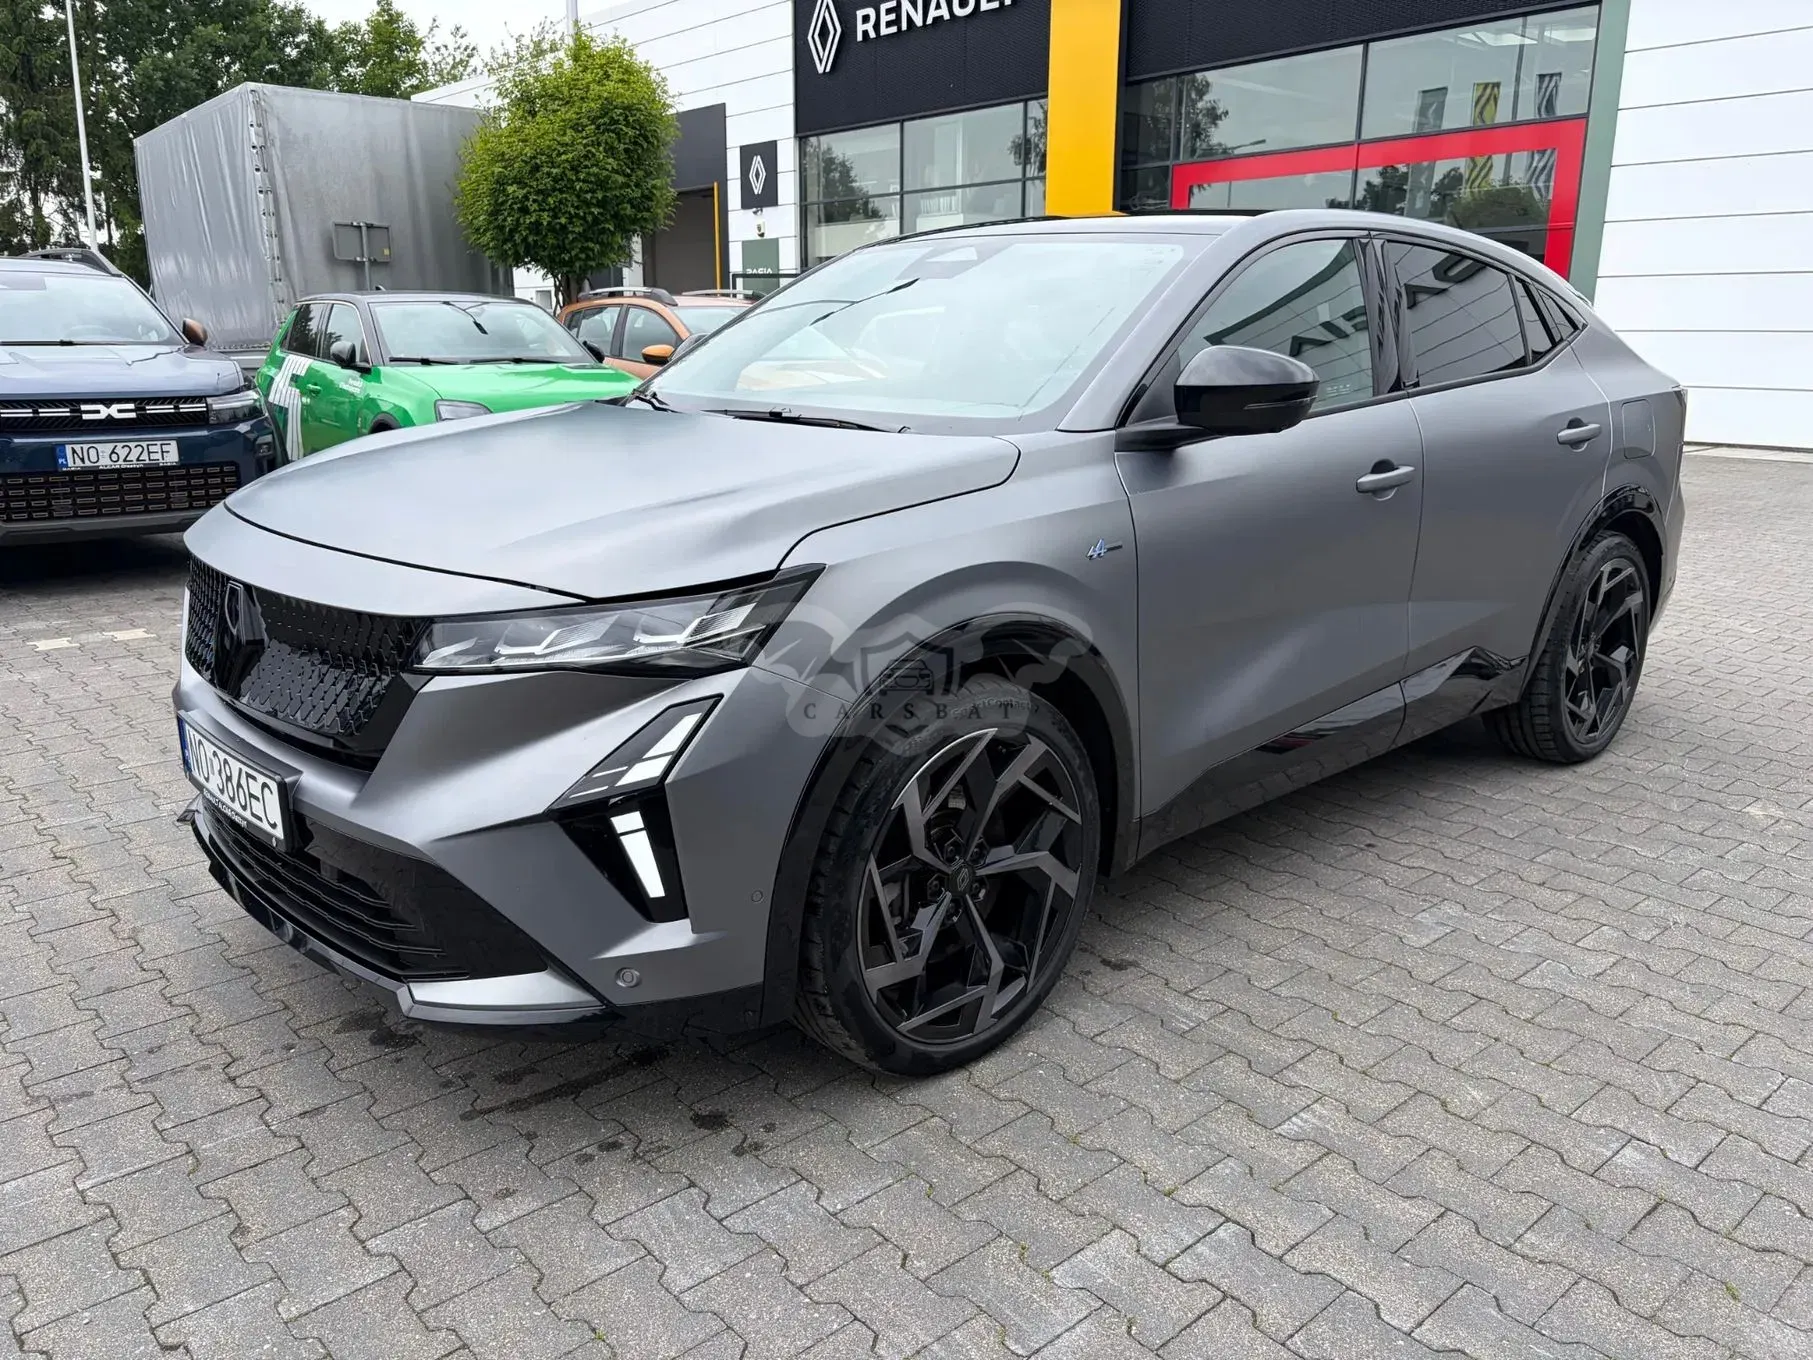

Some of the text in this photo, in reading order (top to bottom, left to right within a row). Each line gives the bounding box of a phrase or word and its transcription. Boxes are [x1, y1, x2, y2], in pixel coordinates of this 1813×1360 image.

[856, 0, 1012, 41] RENAU
[70, 442, 172, 465] NO 622EF
[187, 729, 278, 830] NO 386EC
